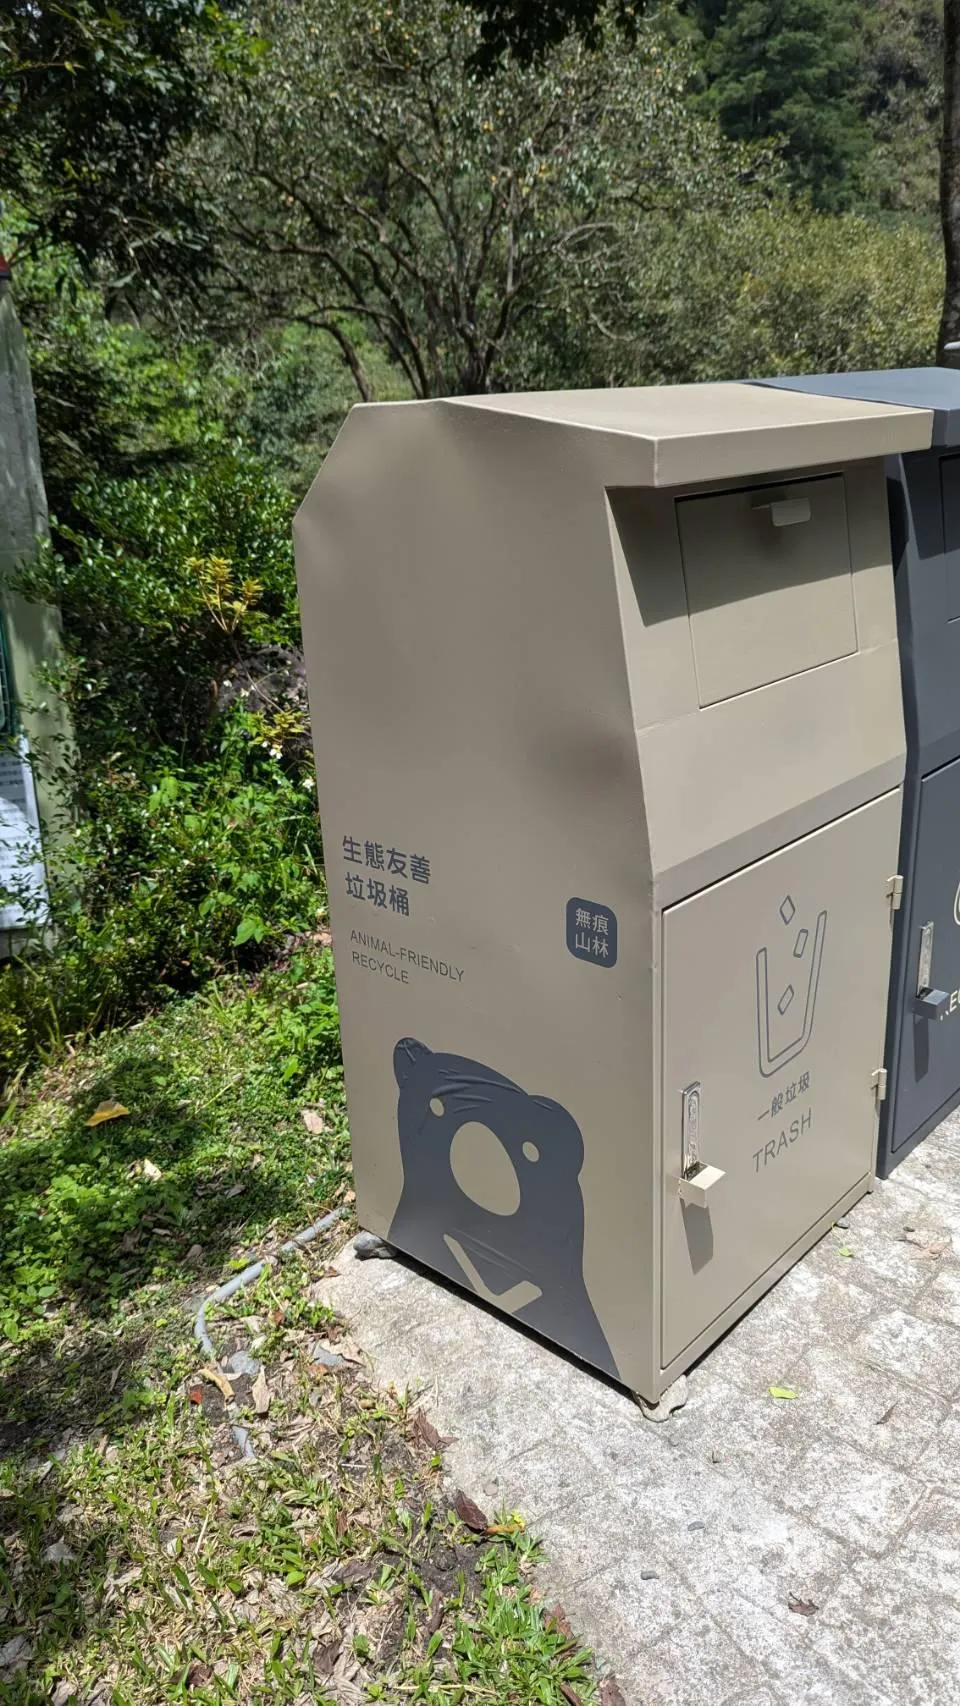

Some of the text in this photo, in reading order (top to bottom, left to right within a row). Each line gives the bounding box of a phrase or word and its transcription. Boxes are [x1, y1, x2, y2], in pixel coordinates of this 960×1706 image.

[342, 835, 431, 884] 生態友善
[344, 872, 410, 917] 垃圾桶
[575, 907, 609, 936] 無痕
[350, 930, 464, 982] ANIMAL-FRIENDLY
[351, 951, 409, 984] RECYCLE
[575, 932, 609, 959] 山林
[757, 1071, 810, 1120] 一般垃圾
[752, 1107, 811, 1172] TRASH
